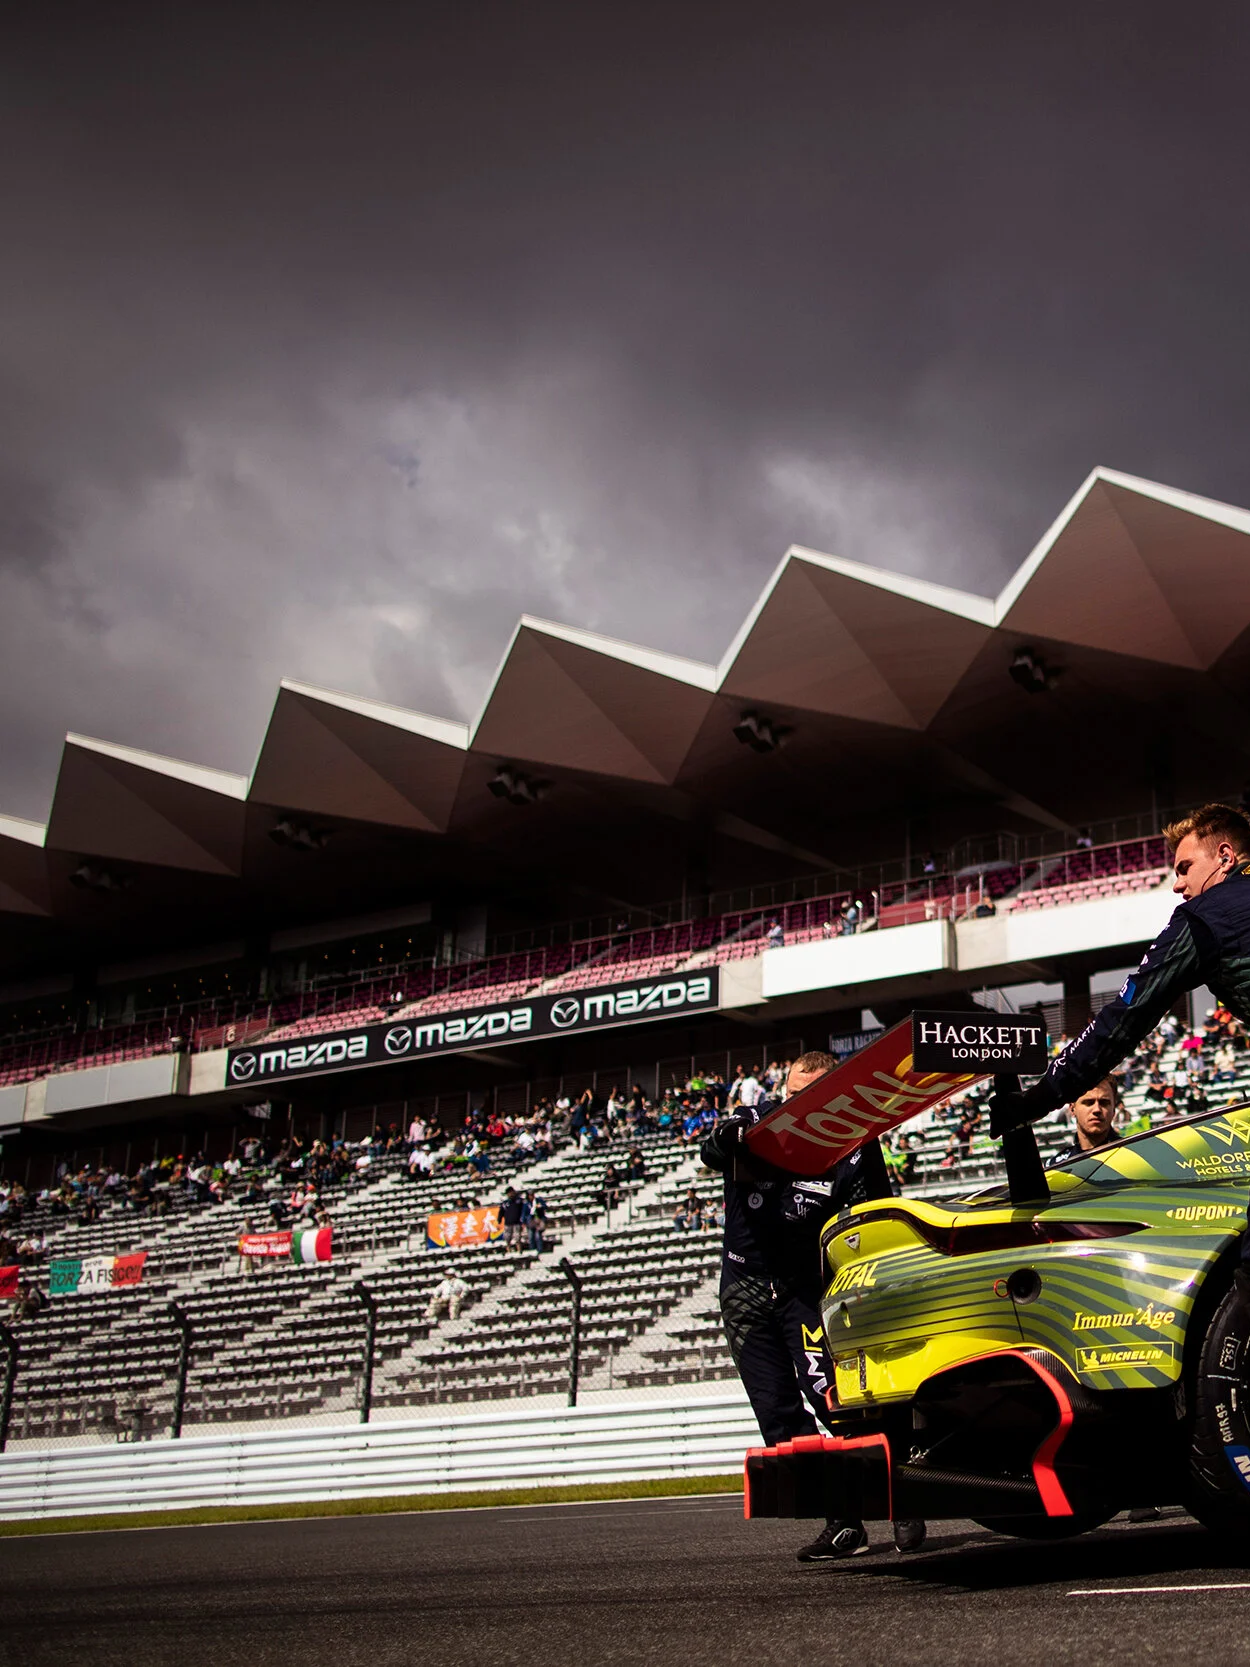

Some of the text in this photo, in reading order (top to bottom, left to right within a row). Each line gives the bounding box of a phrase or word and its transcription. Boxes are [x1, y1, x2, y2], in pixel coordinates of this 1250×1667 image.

[584, 976, 711, 1021] mazda
[415, 1007, 533, 1049] mazda
[920, 1021, 1041, 1046] HACKETT
[259, 1034, 368, 1074] mazda
[951, 1047, 1012, 1061] LONDON
[766, 1071, 954, 1148] TOTAL
[1195, 1164, 1243, 1176] HOTELS
[1174, 1205, 1236, 1221] DUPONT
[51, 1269, 93, 1287] FORZA
[826, 1260, 879, 1298] TOTAL
[1099, 1349, 1164, 1363] MICHELIN
